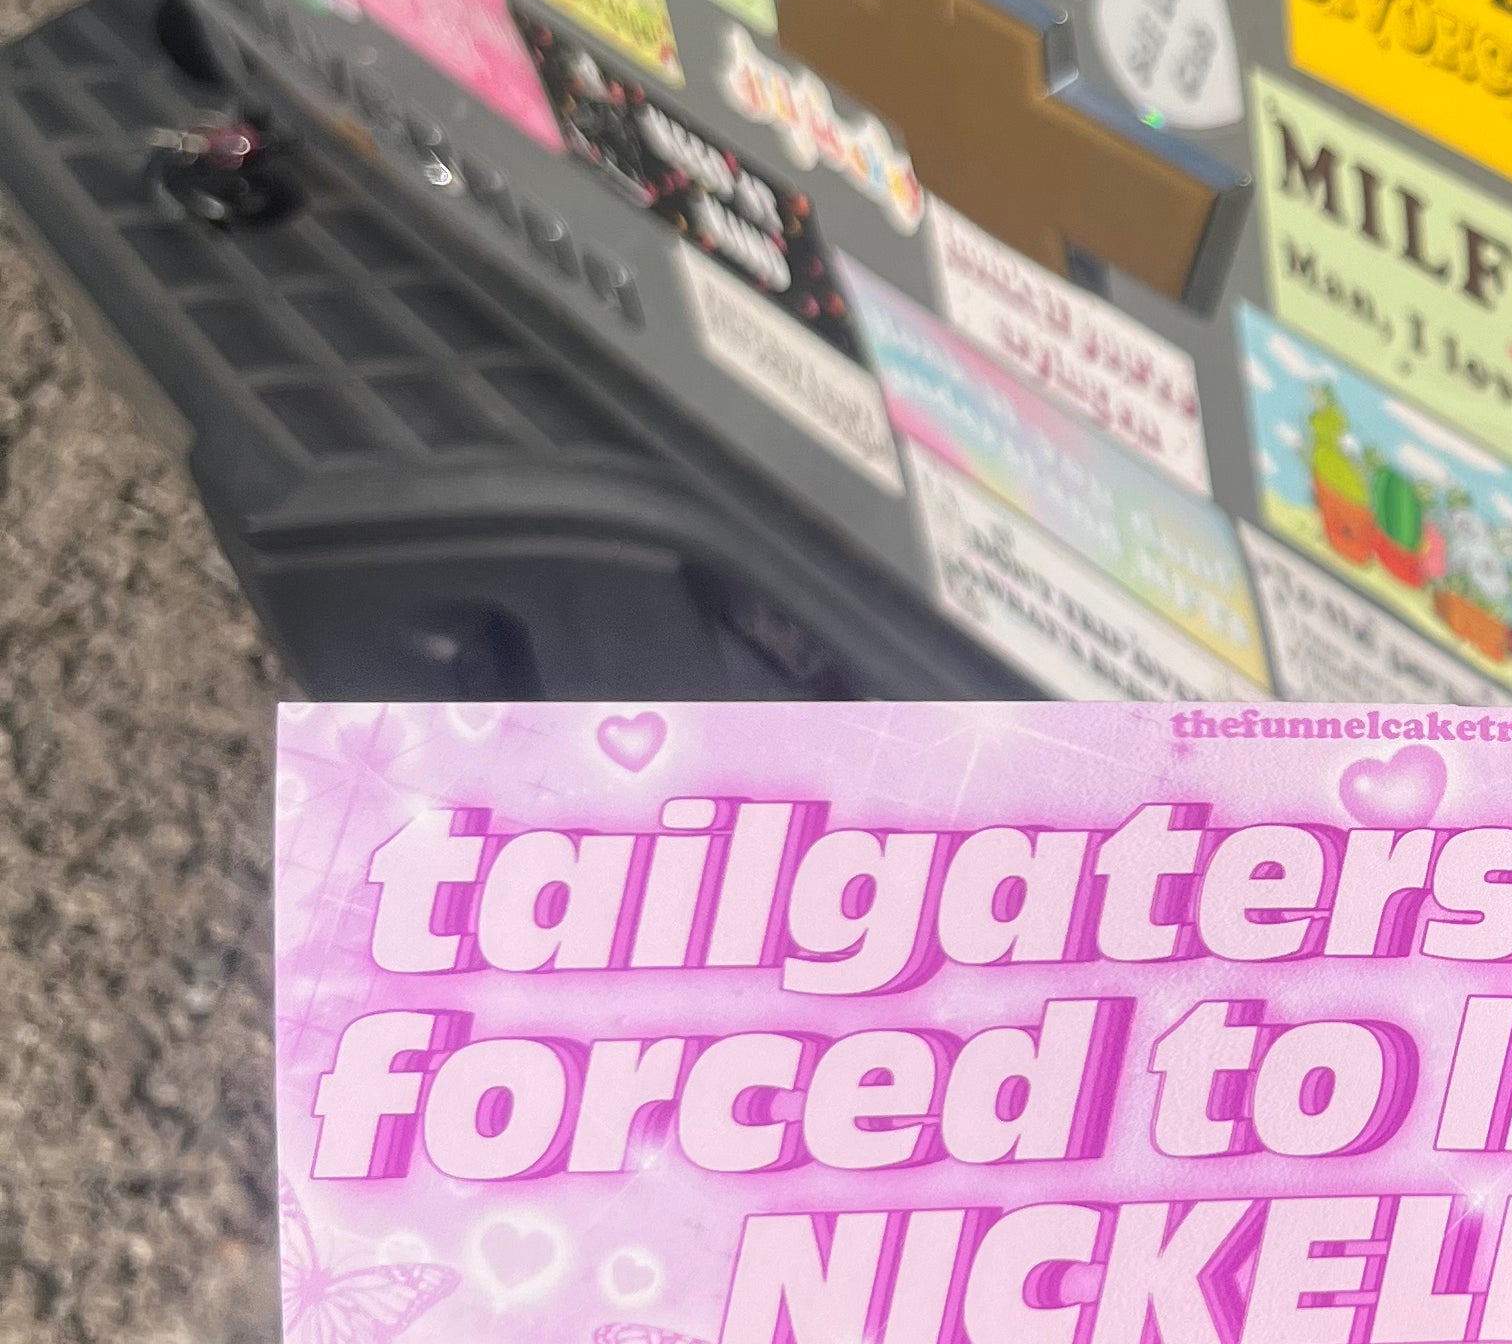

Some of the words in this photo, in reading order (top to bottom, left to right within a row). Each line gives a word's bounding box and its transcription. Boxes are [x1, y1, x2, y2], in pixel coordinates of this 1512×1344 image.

[1281, 236, 1394, 346] Man,
[1405, 306, 1428, 353] I
[310, 996, 1136, 1181] forced
[1150, 998, 1419, 1160] to
